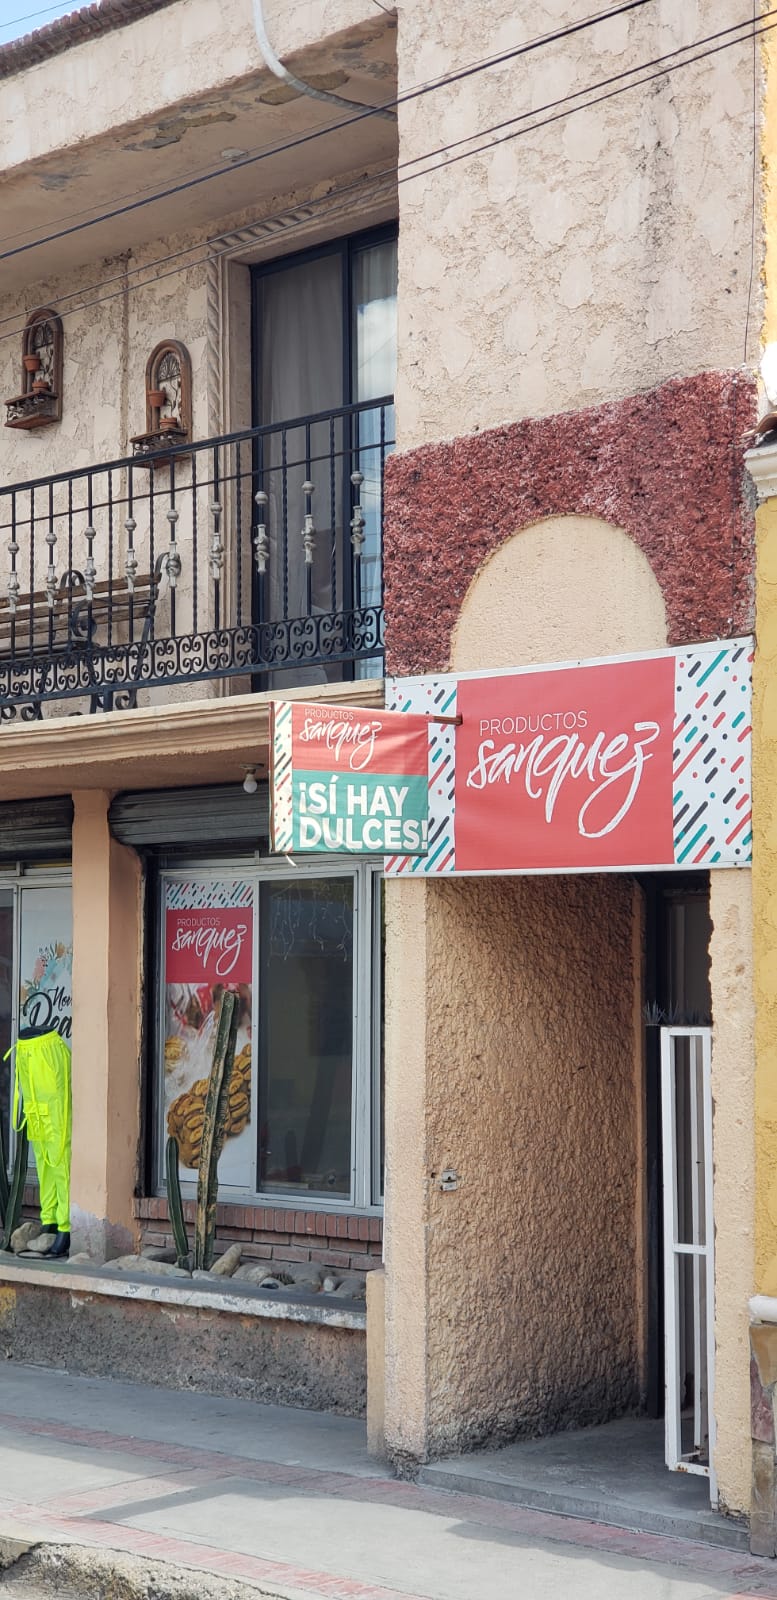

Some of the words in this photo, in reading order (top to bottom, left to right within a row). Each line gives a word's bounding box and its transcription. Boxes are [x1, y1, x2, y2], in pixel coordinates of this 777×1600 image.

[304, 708, 354, 720] PRODUCTOS
[479, 710, 588, 736] PRODUCTOS
[299, 774, 339, 815] ¡SÍ
[347, 784, 409, 817] HAY
[299, 816, 428, 850] DULCES!
[177, 917, 221, 927] PRODUCTOS
